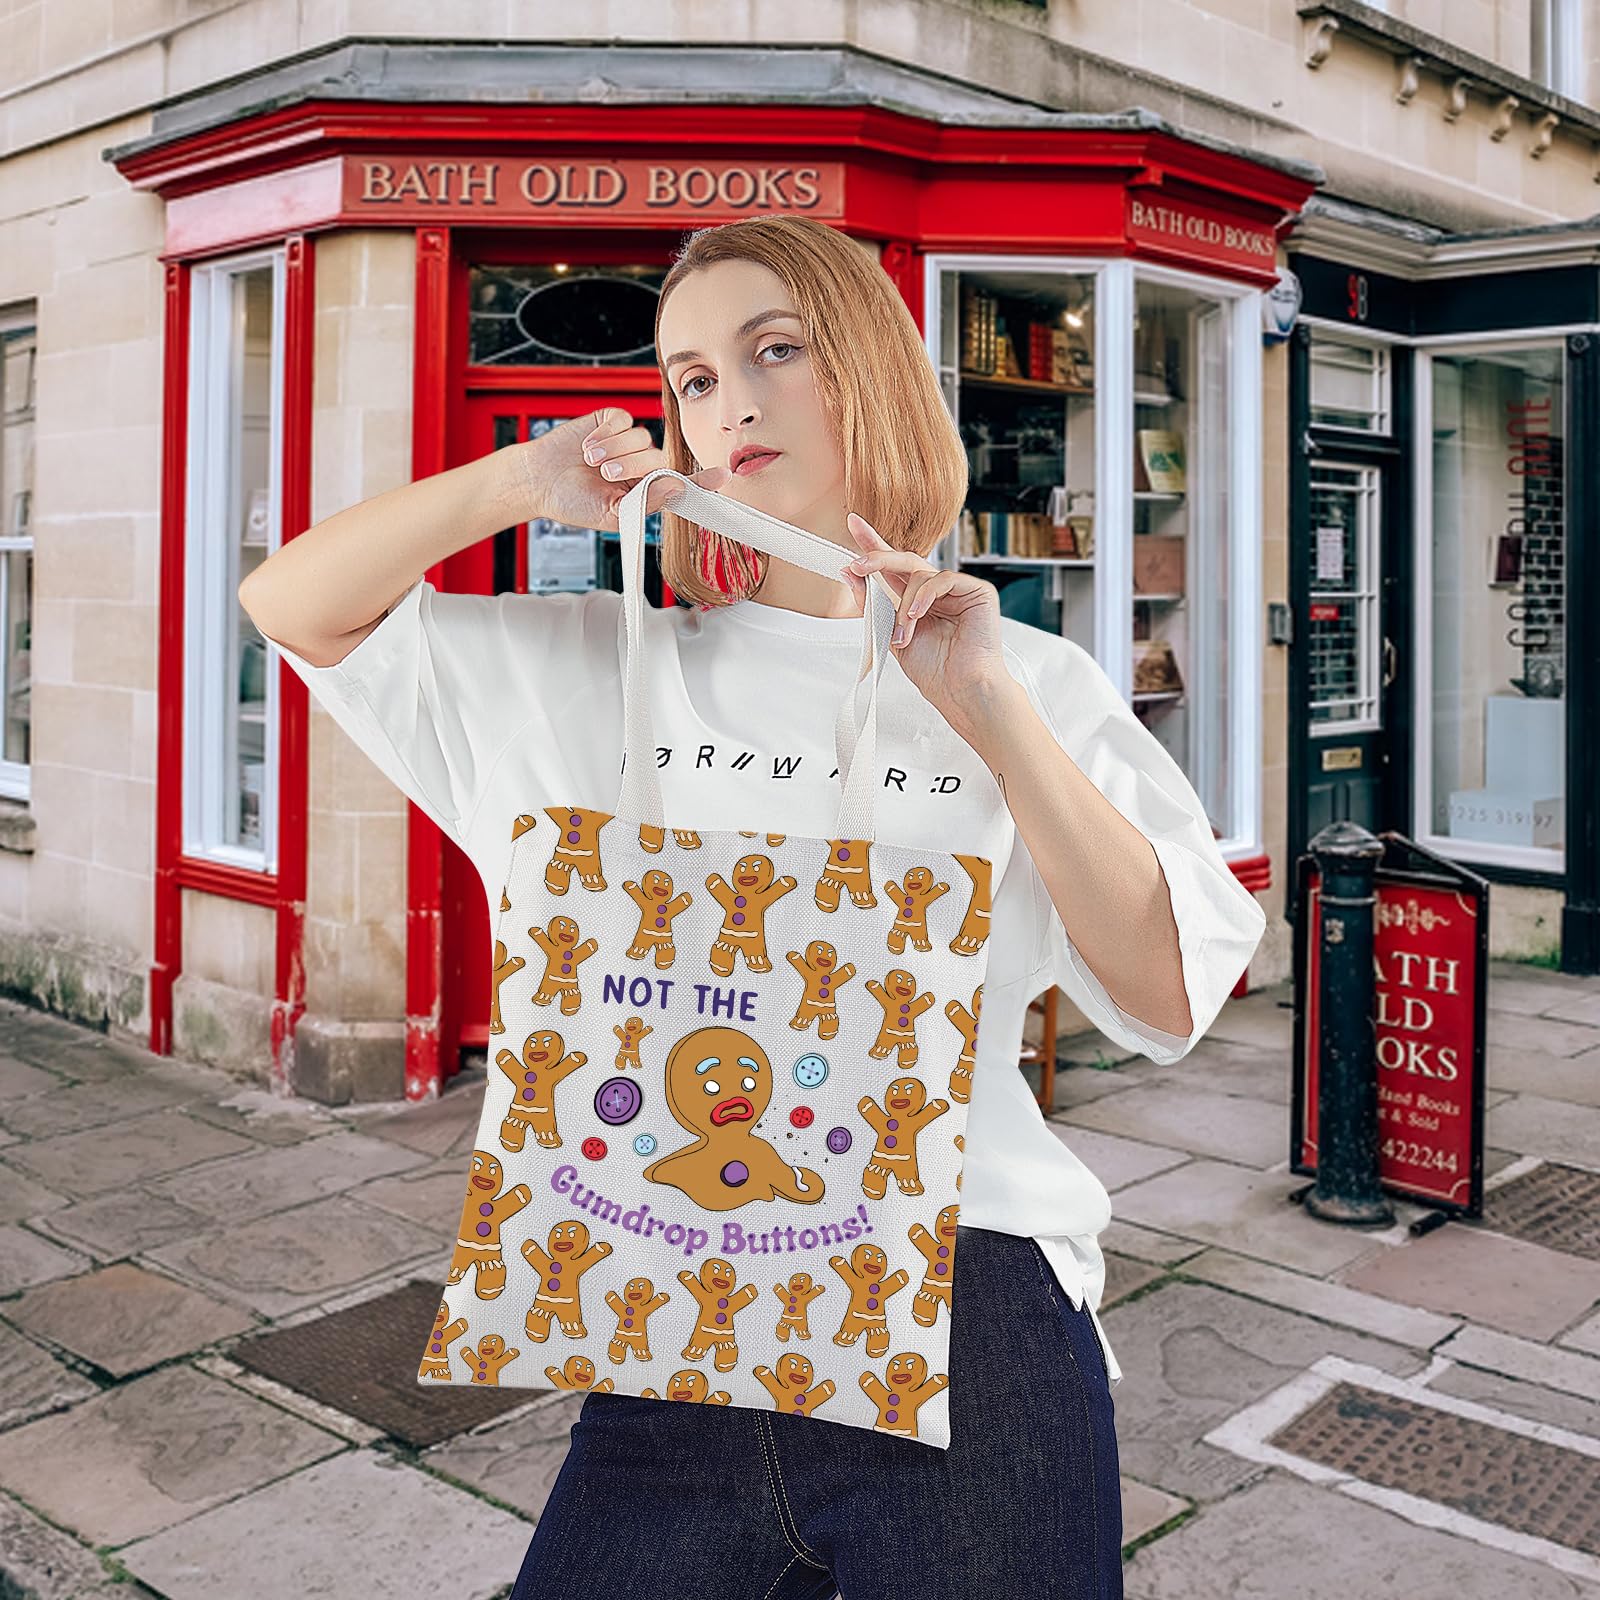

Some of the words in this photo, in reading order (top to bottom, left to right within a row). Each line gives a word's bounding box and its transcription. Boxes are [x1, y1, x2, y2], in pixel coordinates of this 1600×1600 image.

[361, 162, 498, 204] BATH
[520, 166, 627, 207] OLD
[646, 167, 820, 209] BOOKS
[1132, 200, 1184, 236] BATH
[1186, 216, 1222, 244] OLD
[1224, 226, 1274, 256] BOOKS
[1373, 951, 1459, 995] TH
[603, 974, 675, 1010] NOT
[693, 984, 759, 1022] THE
[1377, 991, 1433, 1032] LD
[1376, 1036, 1458, 1082] OKS
[1408, 1111, 1440, 1131] Sold
[1417, 1094, 1461, 1116] Books
[1381, 1138, 1458, 1174] 422244
[550, 1165, 709, 1256] Gumdrop
[720, 1203, 874, 1255] Buttons!
